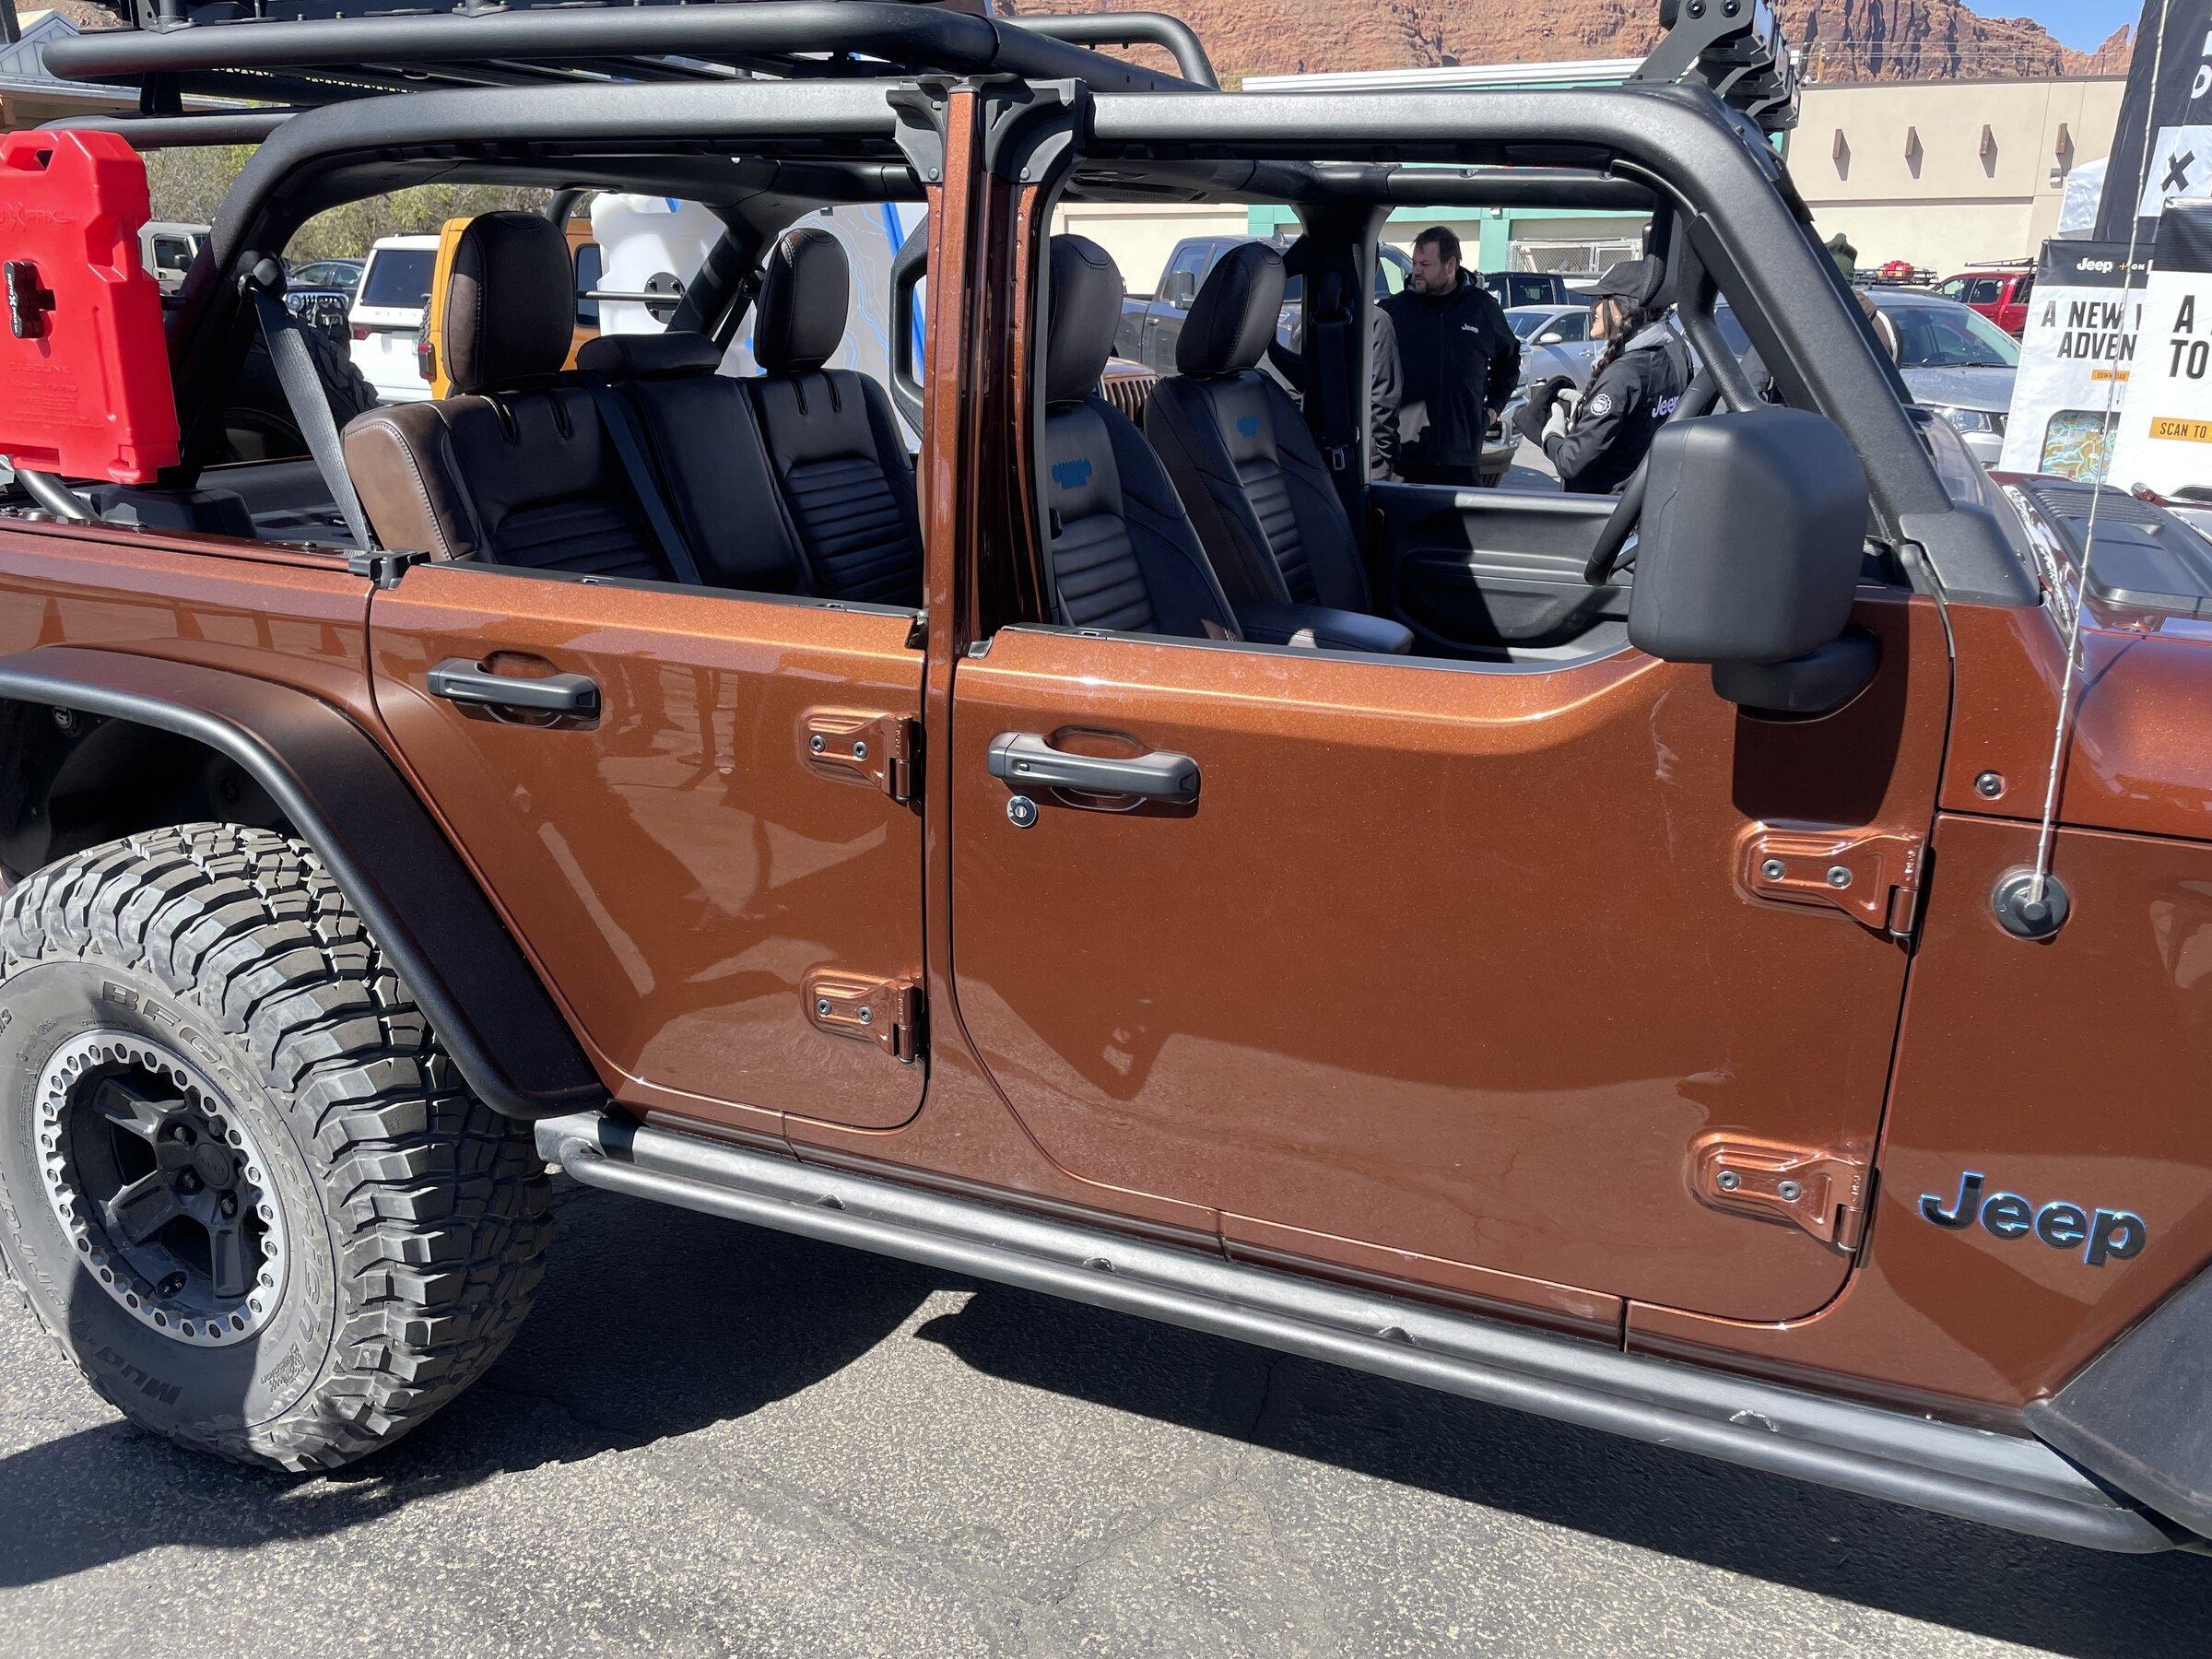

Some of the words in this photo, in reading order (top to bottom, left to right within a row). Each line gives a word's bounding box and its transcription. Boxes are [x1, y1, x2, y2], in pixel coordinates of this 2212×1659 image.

[2077, 257, 2113, 274] Jeep
[2041, 300, 2057, 328] A
[2067, 300, 2125, 330] NEW
[2172, 294, 2194, 335] A
[2169, 338, 2210, 380] TO
[2159, 422, 2189, 437] SCAN
[2194, 425, 2207, 439] TO
[1920, 1171, 2147, 1267] Jeep
